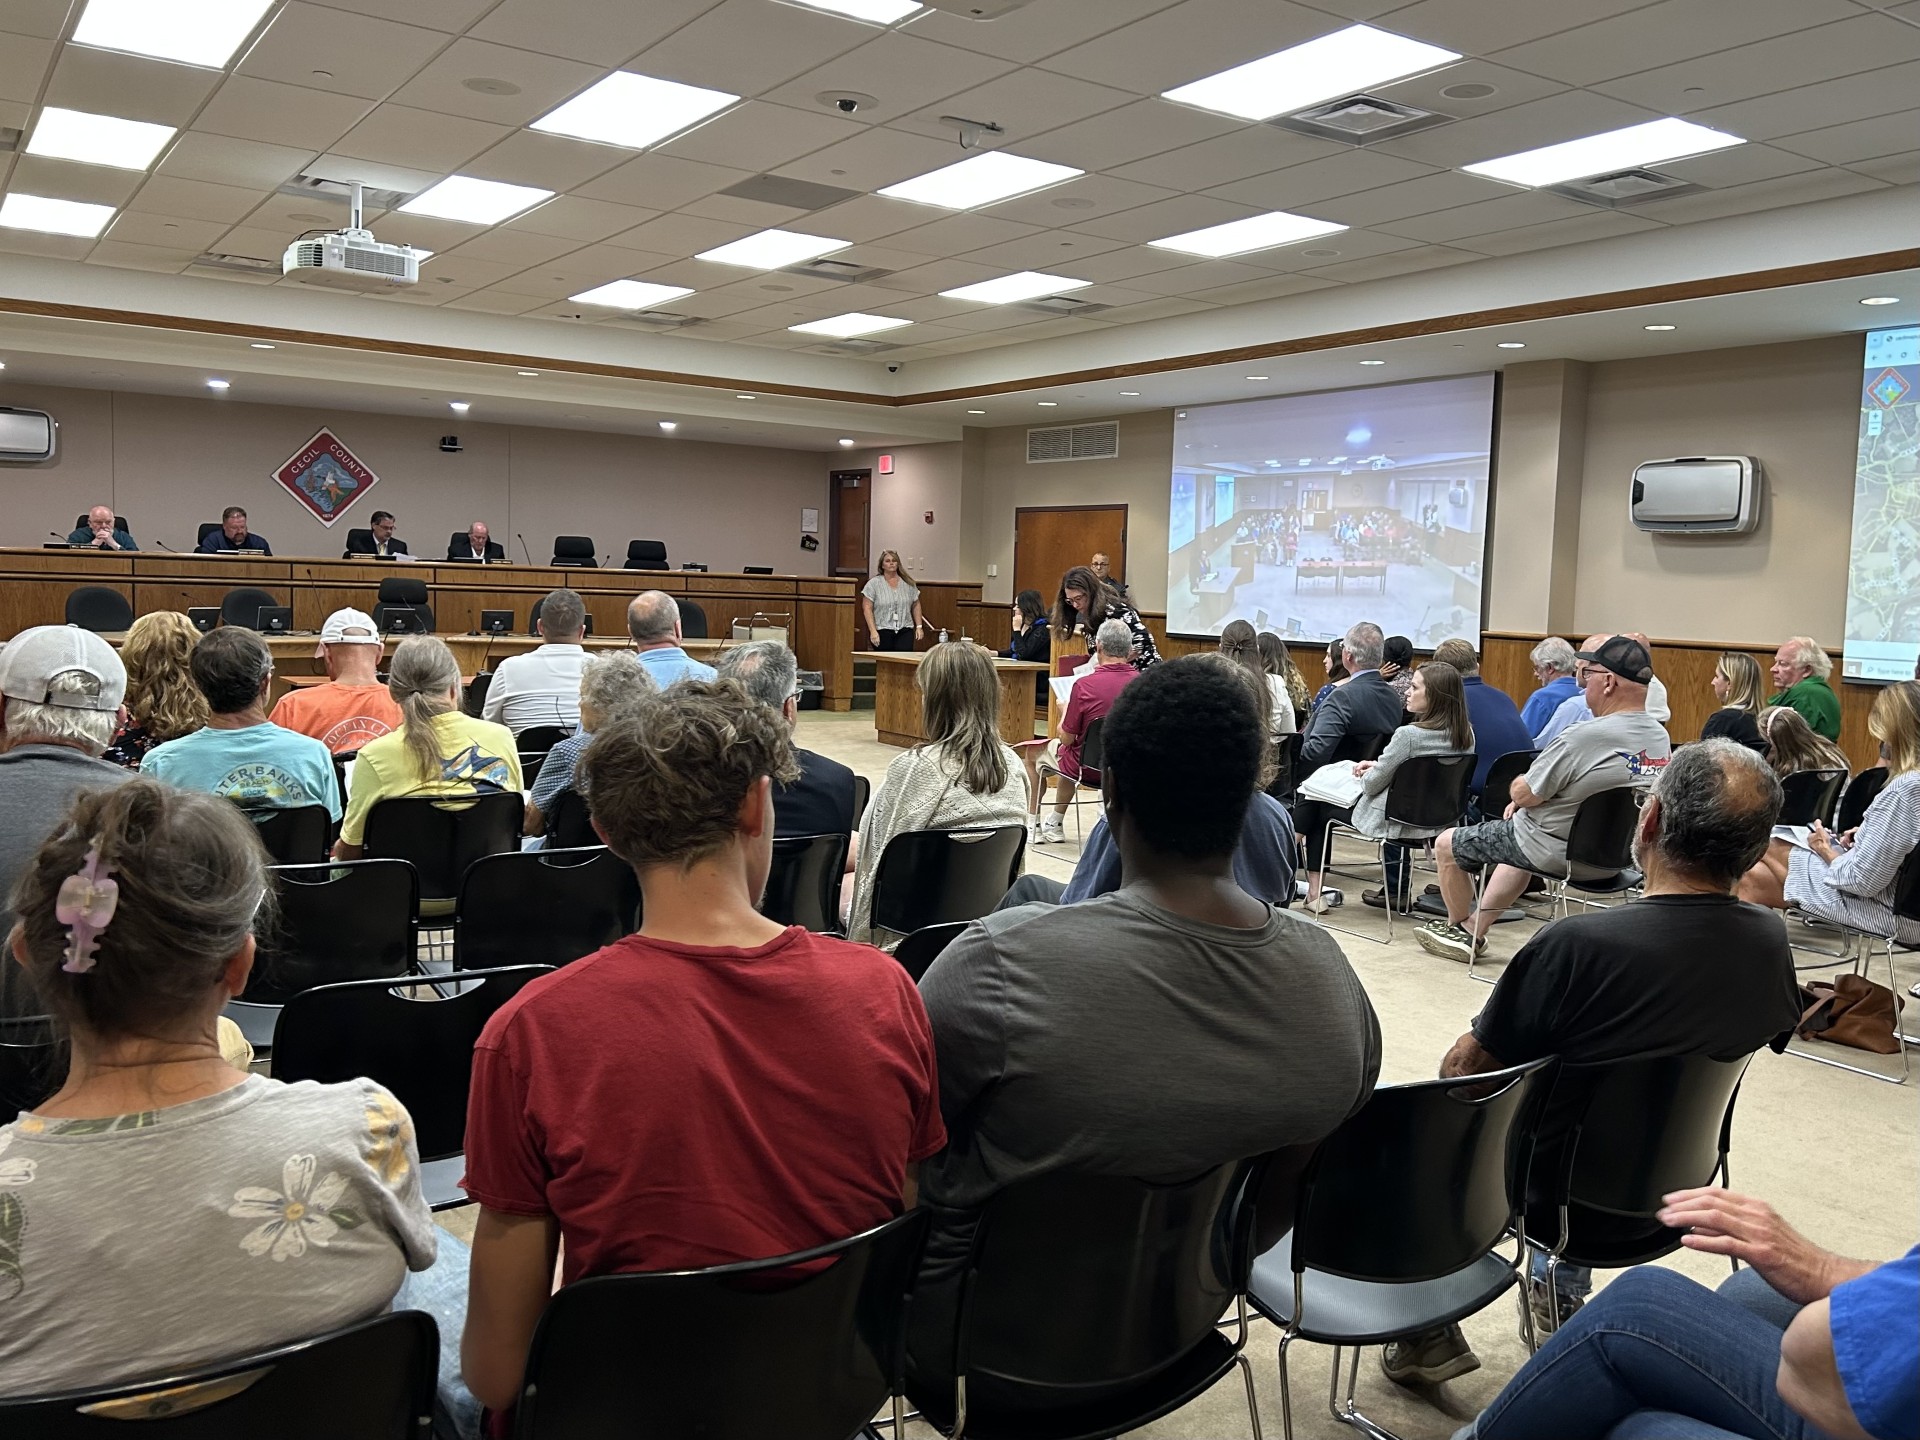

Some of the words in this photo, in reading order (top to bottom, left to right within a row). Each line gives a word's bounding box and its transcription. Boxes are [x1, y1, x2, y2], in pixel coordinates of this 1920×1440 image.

[291, 448, 320, 474] CECIL
[330, 444, 367, 478] COUNTY
[215, 768, 249, 798] UTER
[255, 766, 302, 800] BANKS
